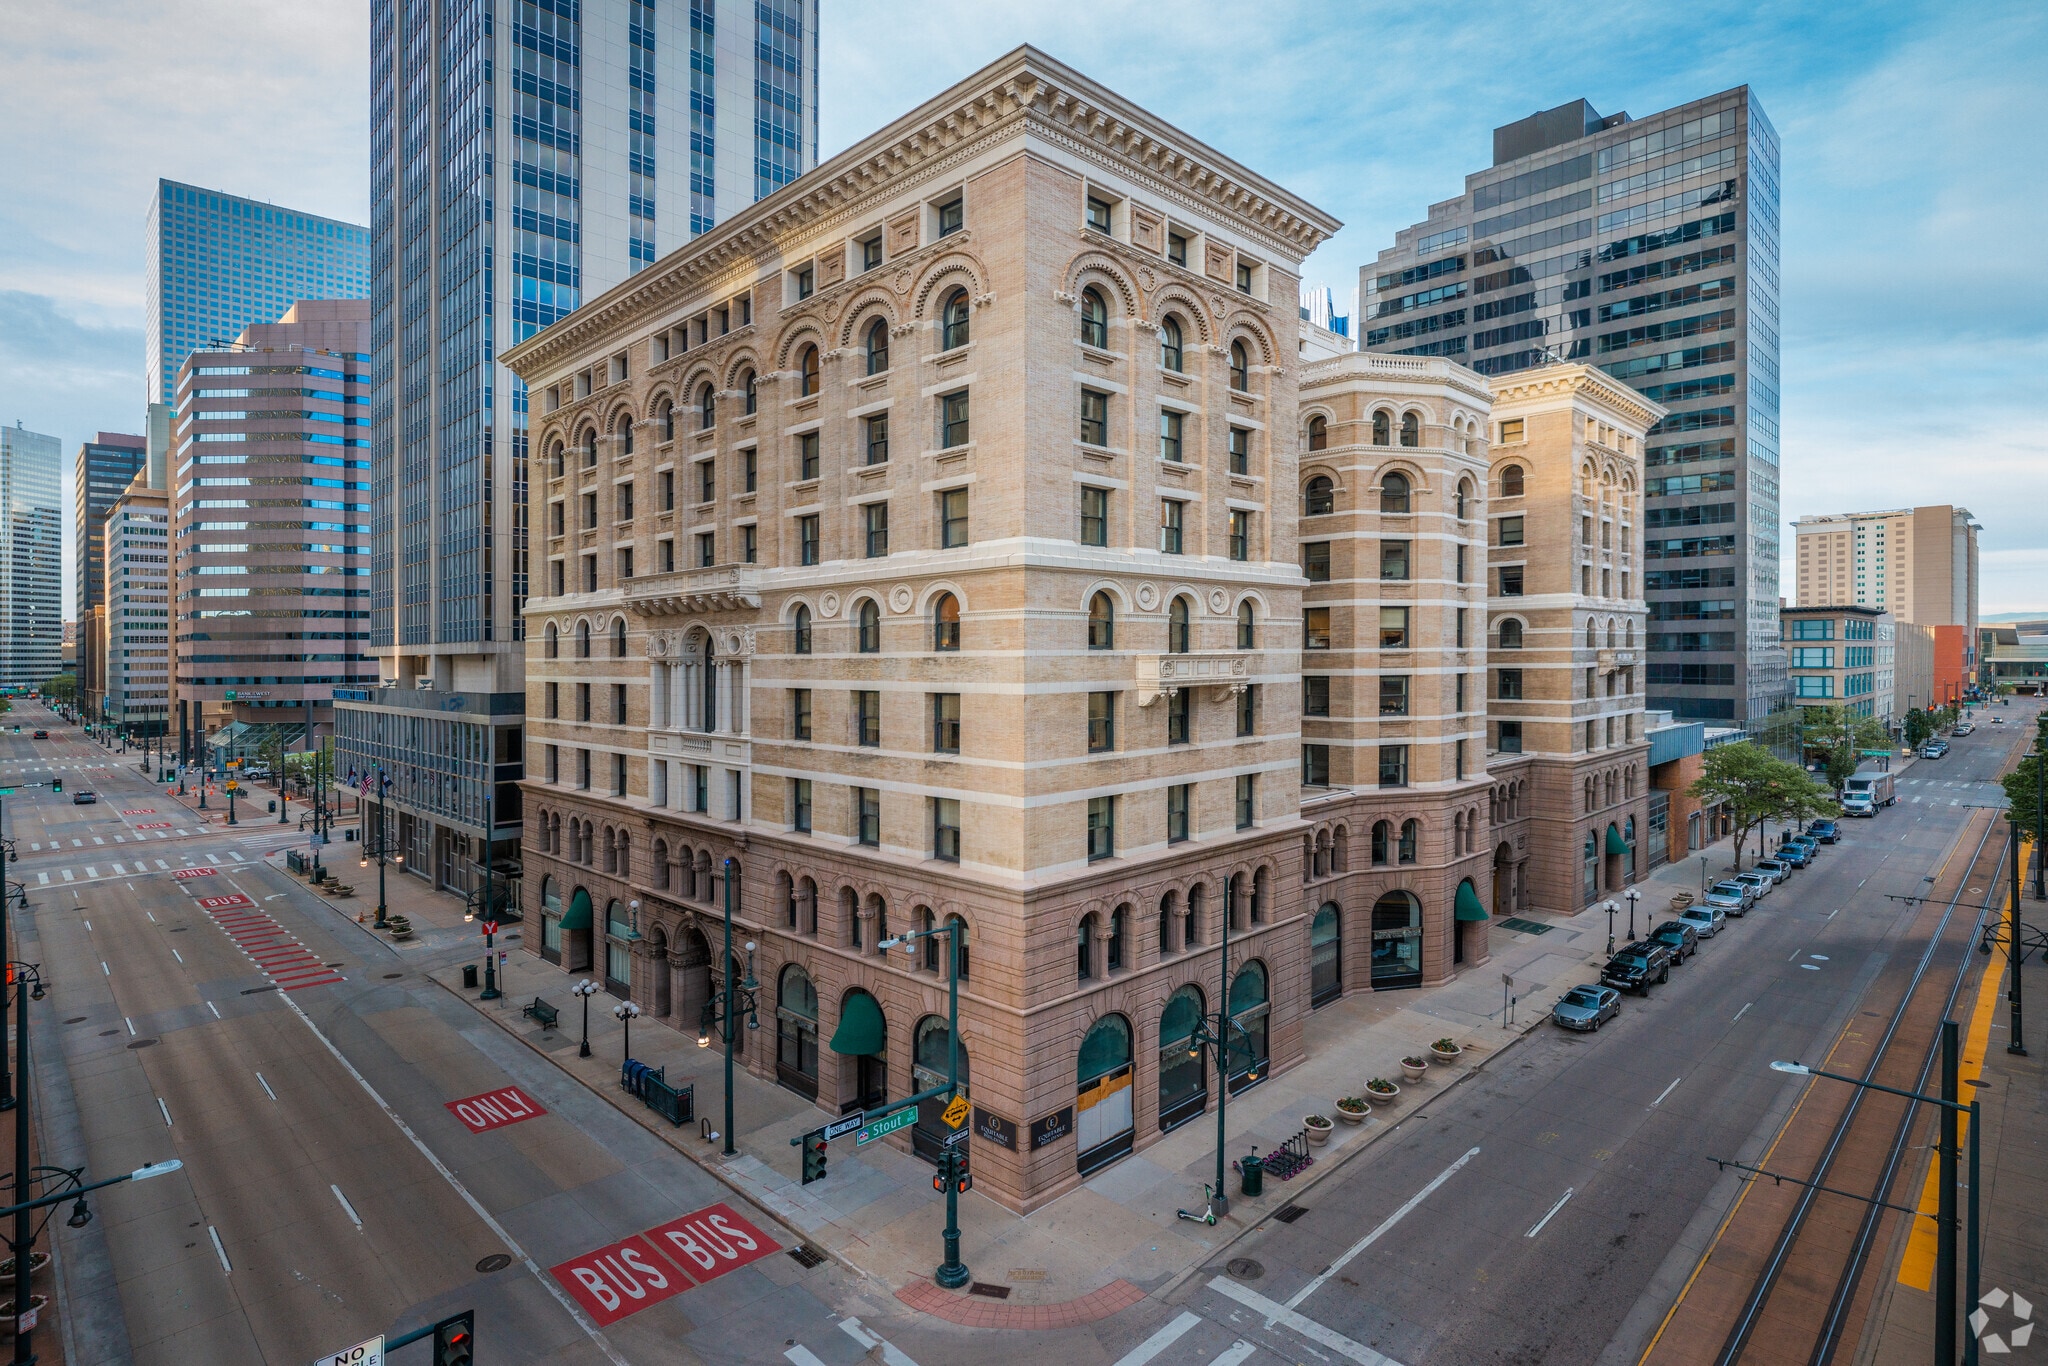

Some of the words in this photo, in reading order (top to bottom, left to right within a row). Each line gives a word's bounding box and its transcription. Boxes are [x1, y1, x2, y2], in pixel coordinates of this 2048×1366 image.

[176, 868, 213, 878] ONLY
[206, 895, 242, 907] BUS
[456, 1090, 534, 1127] ONLY
[829, 1124, 843, 1135] ONE
[844, 1119, 859, 1130] WAY
[873, 1115, 902, 1136] Stout
[980, 1125, 1009, 1142] EQUITABLE
[1038, 1124, 1066, 1142] EQUITABLE
[983, 1132, 1007, 1147] BUILDING
[1040, 1132, 1064, 1146] BUILDING
[665, 1214, 758, 1270] BUS
[571, 1247, 669, 1312] BUS
[335, 1347, 365, 1366] NO
